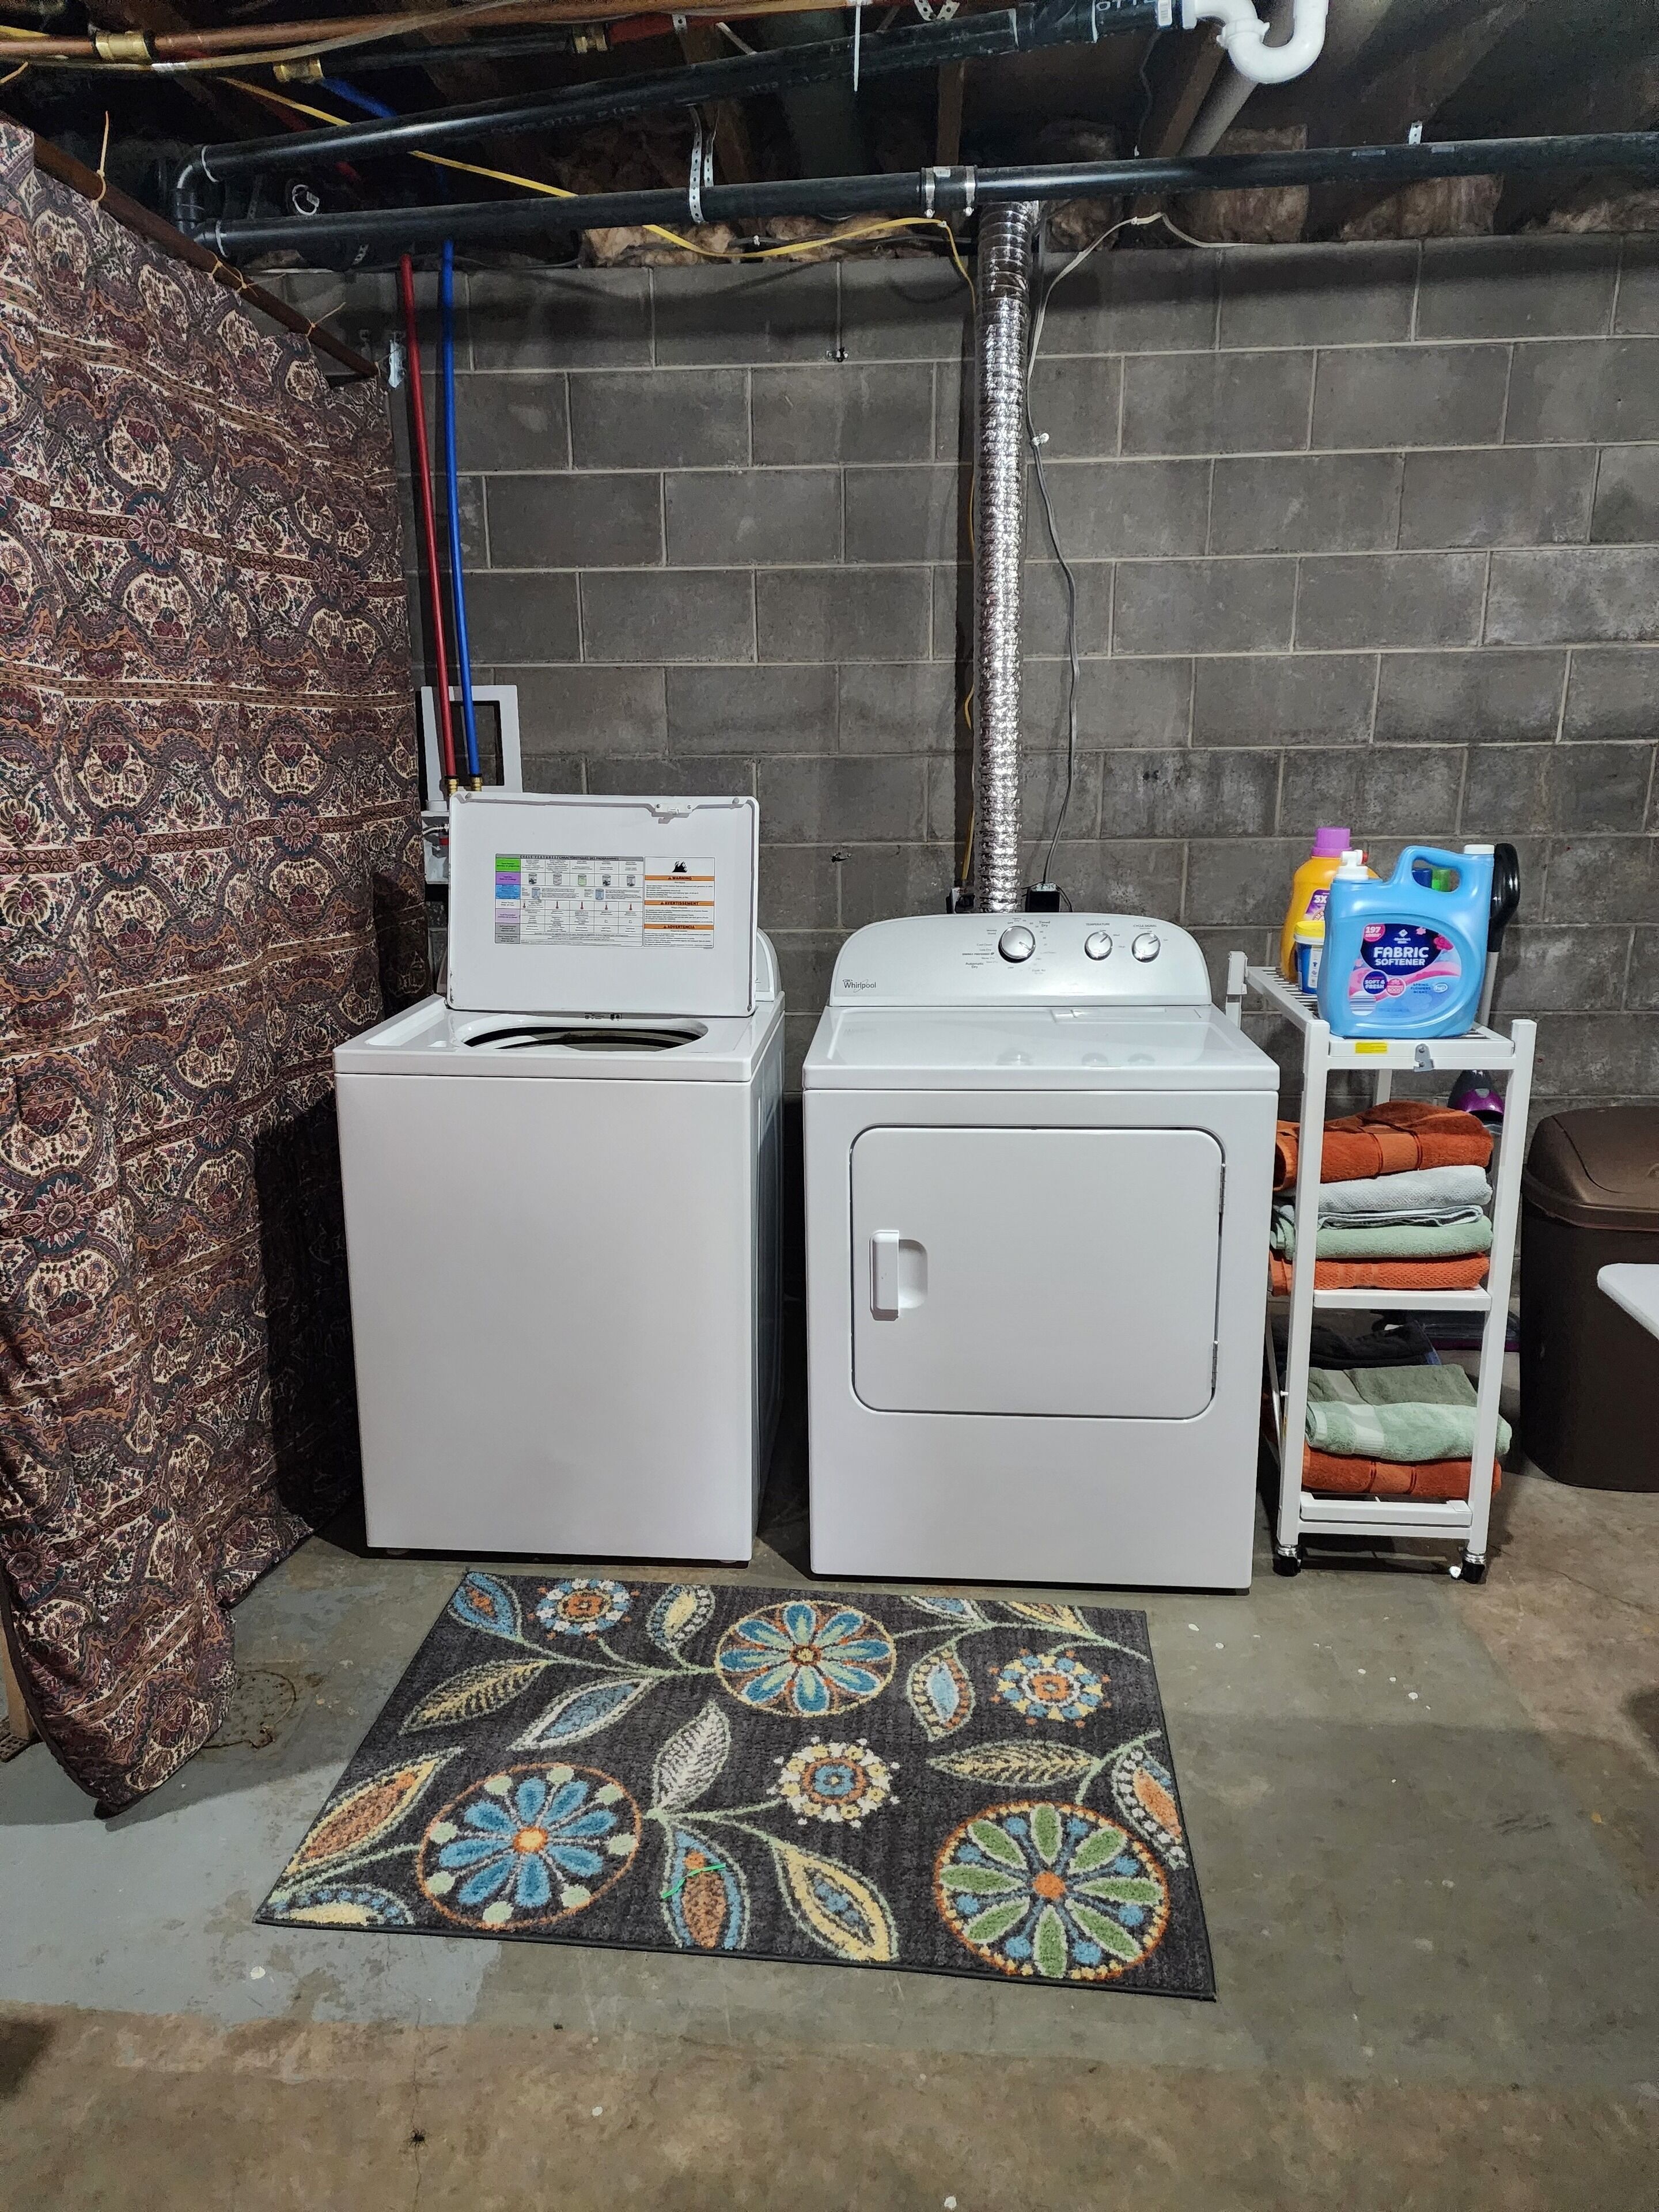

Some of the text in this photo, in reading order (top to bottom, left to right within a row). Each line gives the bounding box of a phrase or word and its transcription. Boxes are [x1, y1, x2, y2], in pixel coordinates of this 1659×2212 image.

[1314, 895, 1328, 903] 3X
[1373, 946, 1430, 958] FABRIC
[1375, 958, 1426, 966] SOFTENER
[843, 980, 876, 991] Whirlpool
